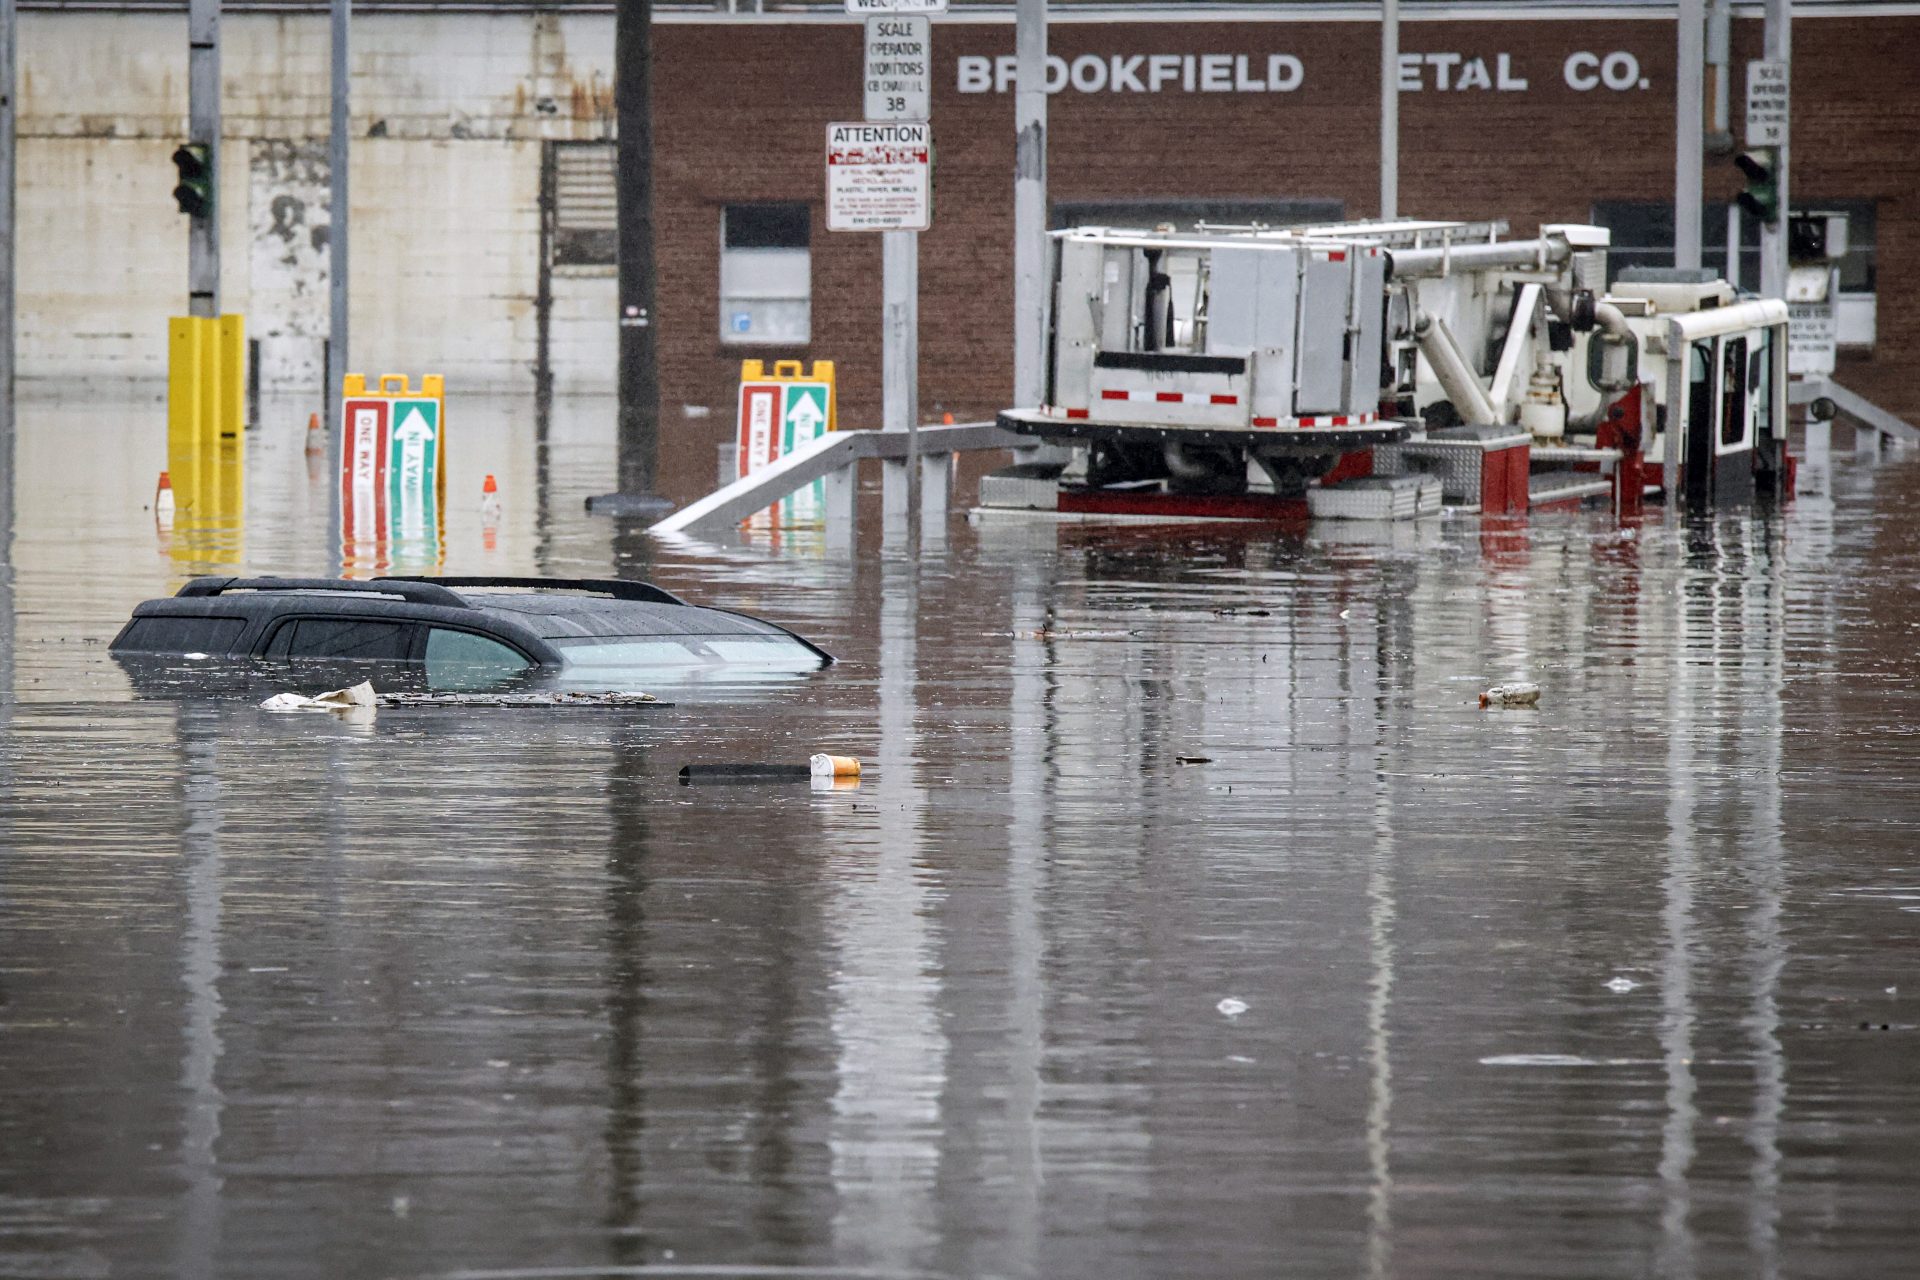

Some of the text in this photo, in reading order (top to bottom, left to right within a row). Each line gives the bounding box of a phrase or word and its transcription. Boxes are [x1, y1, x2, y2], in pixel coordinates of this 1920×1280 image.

[877, 22, 913, 37] SCALE
[869, 42, 922, 56] OPERATOR
[869, 62, 924, 76] MONITORS
[1564, 51, 1649, 90] CO.
[886, 98, 906, 112] 38
[834, 127, 923, 142] ATTENTION
[407, 431, 420, 446] IN
[358, 416, 373, 480] ONE WAY
